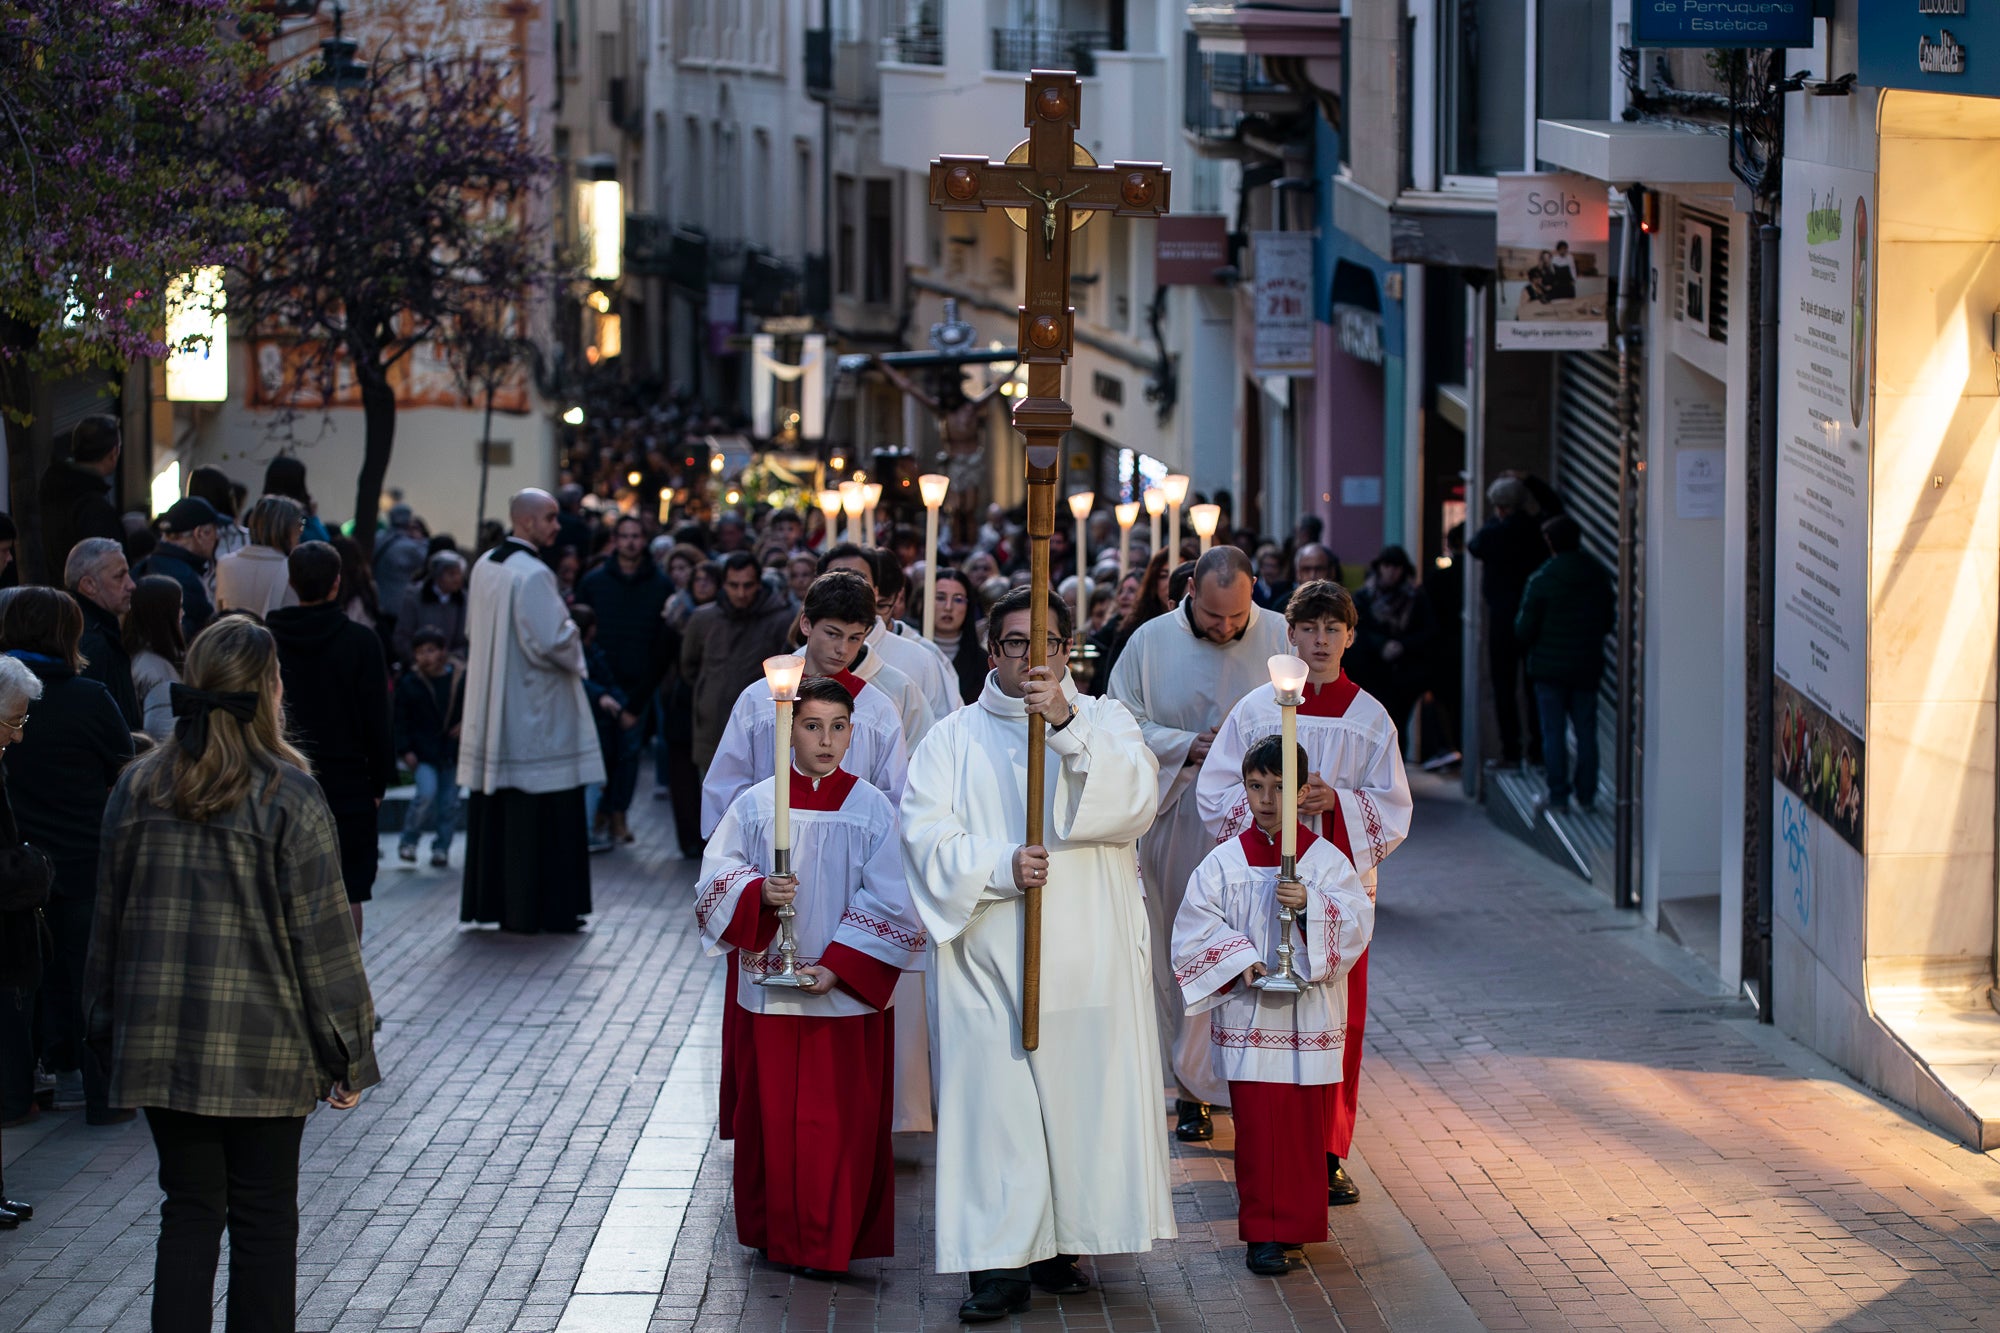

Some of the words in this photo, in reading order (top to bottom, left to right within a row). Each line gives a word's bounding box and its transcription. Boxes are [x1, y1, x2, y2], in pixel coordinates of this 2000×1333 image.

[1654, 1, 1677, 13] de
[1691, 18, 1769, 31] Estètica
[1527, 191, 1581, 216] Solà
